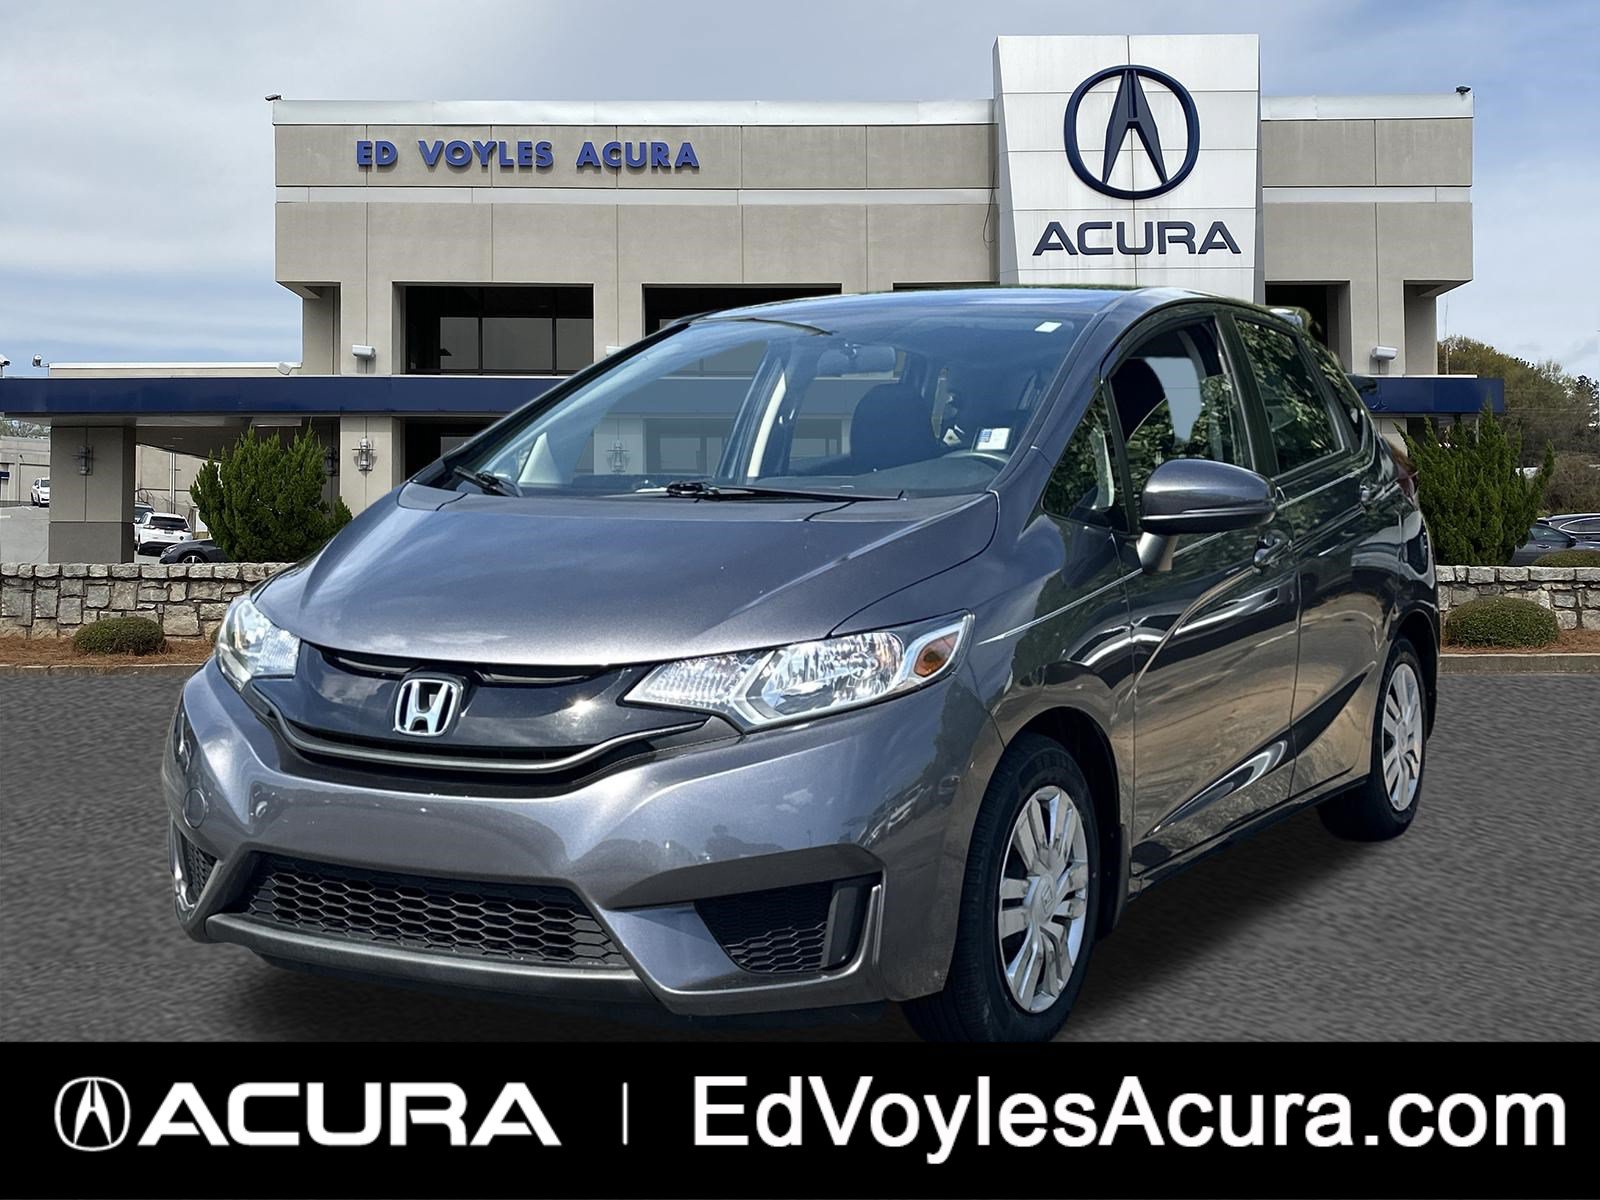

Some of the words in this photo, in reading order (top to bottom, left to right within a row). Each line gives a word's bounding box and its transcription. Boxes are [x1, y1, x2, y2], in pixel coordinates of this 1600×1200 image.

[356, 140, 398, 169] ED
[418, 140, 554, 169] VOYLES
[576, 140, 700, 169] ACURA
[1032, 221, 1242, 256] ACURA
